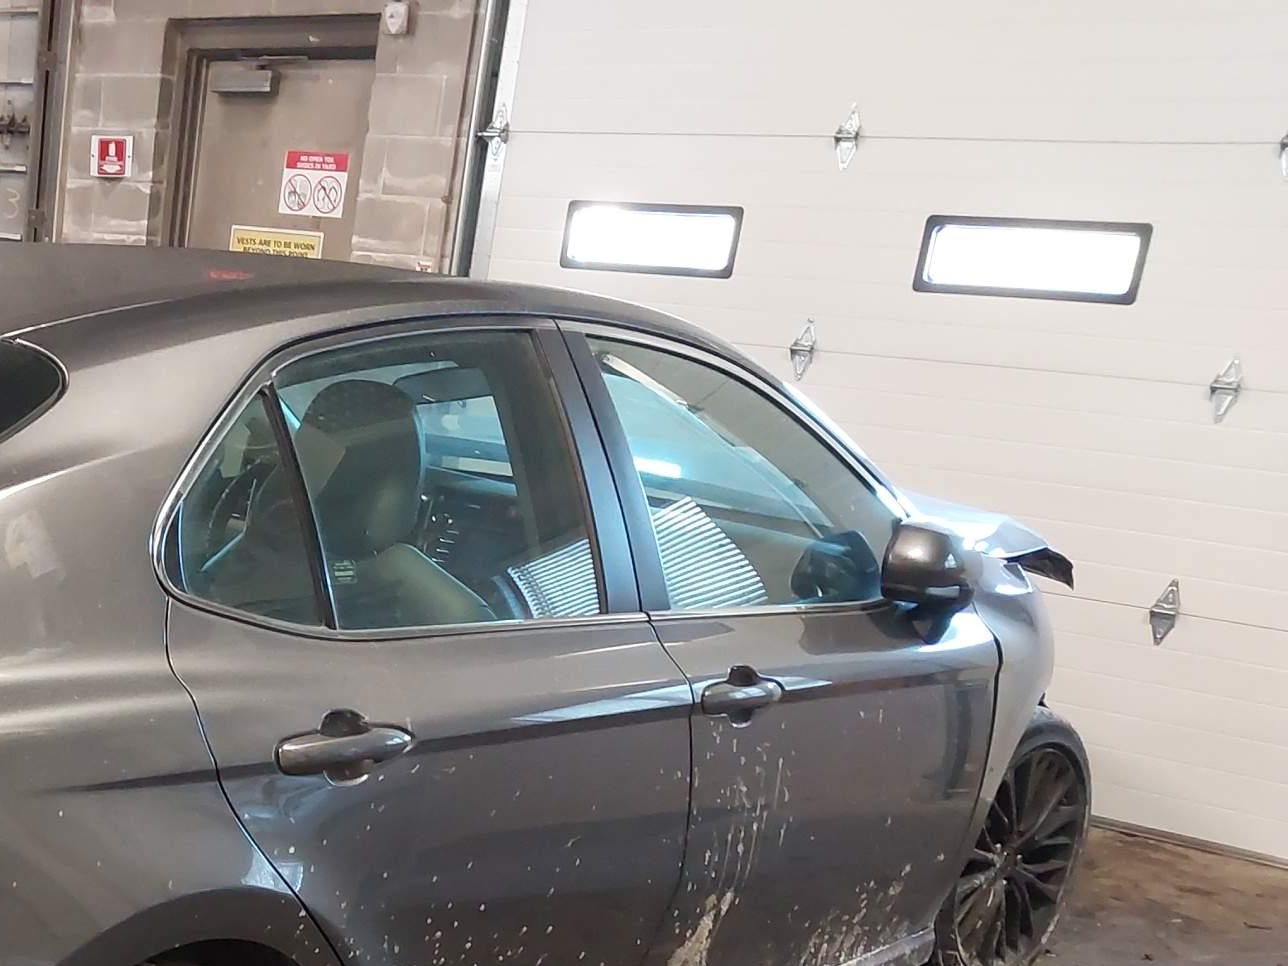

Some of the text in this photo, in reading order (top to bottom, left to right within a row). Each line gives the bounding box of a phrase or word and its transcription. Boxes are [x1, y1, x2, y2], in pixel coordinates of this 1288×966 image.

[237, 236, 315, 250] VESTS ARE TO BE WORN
